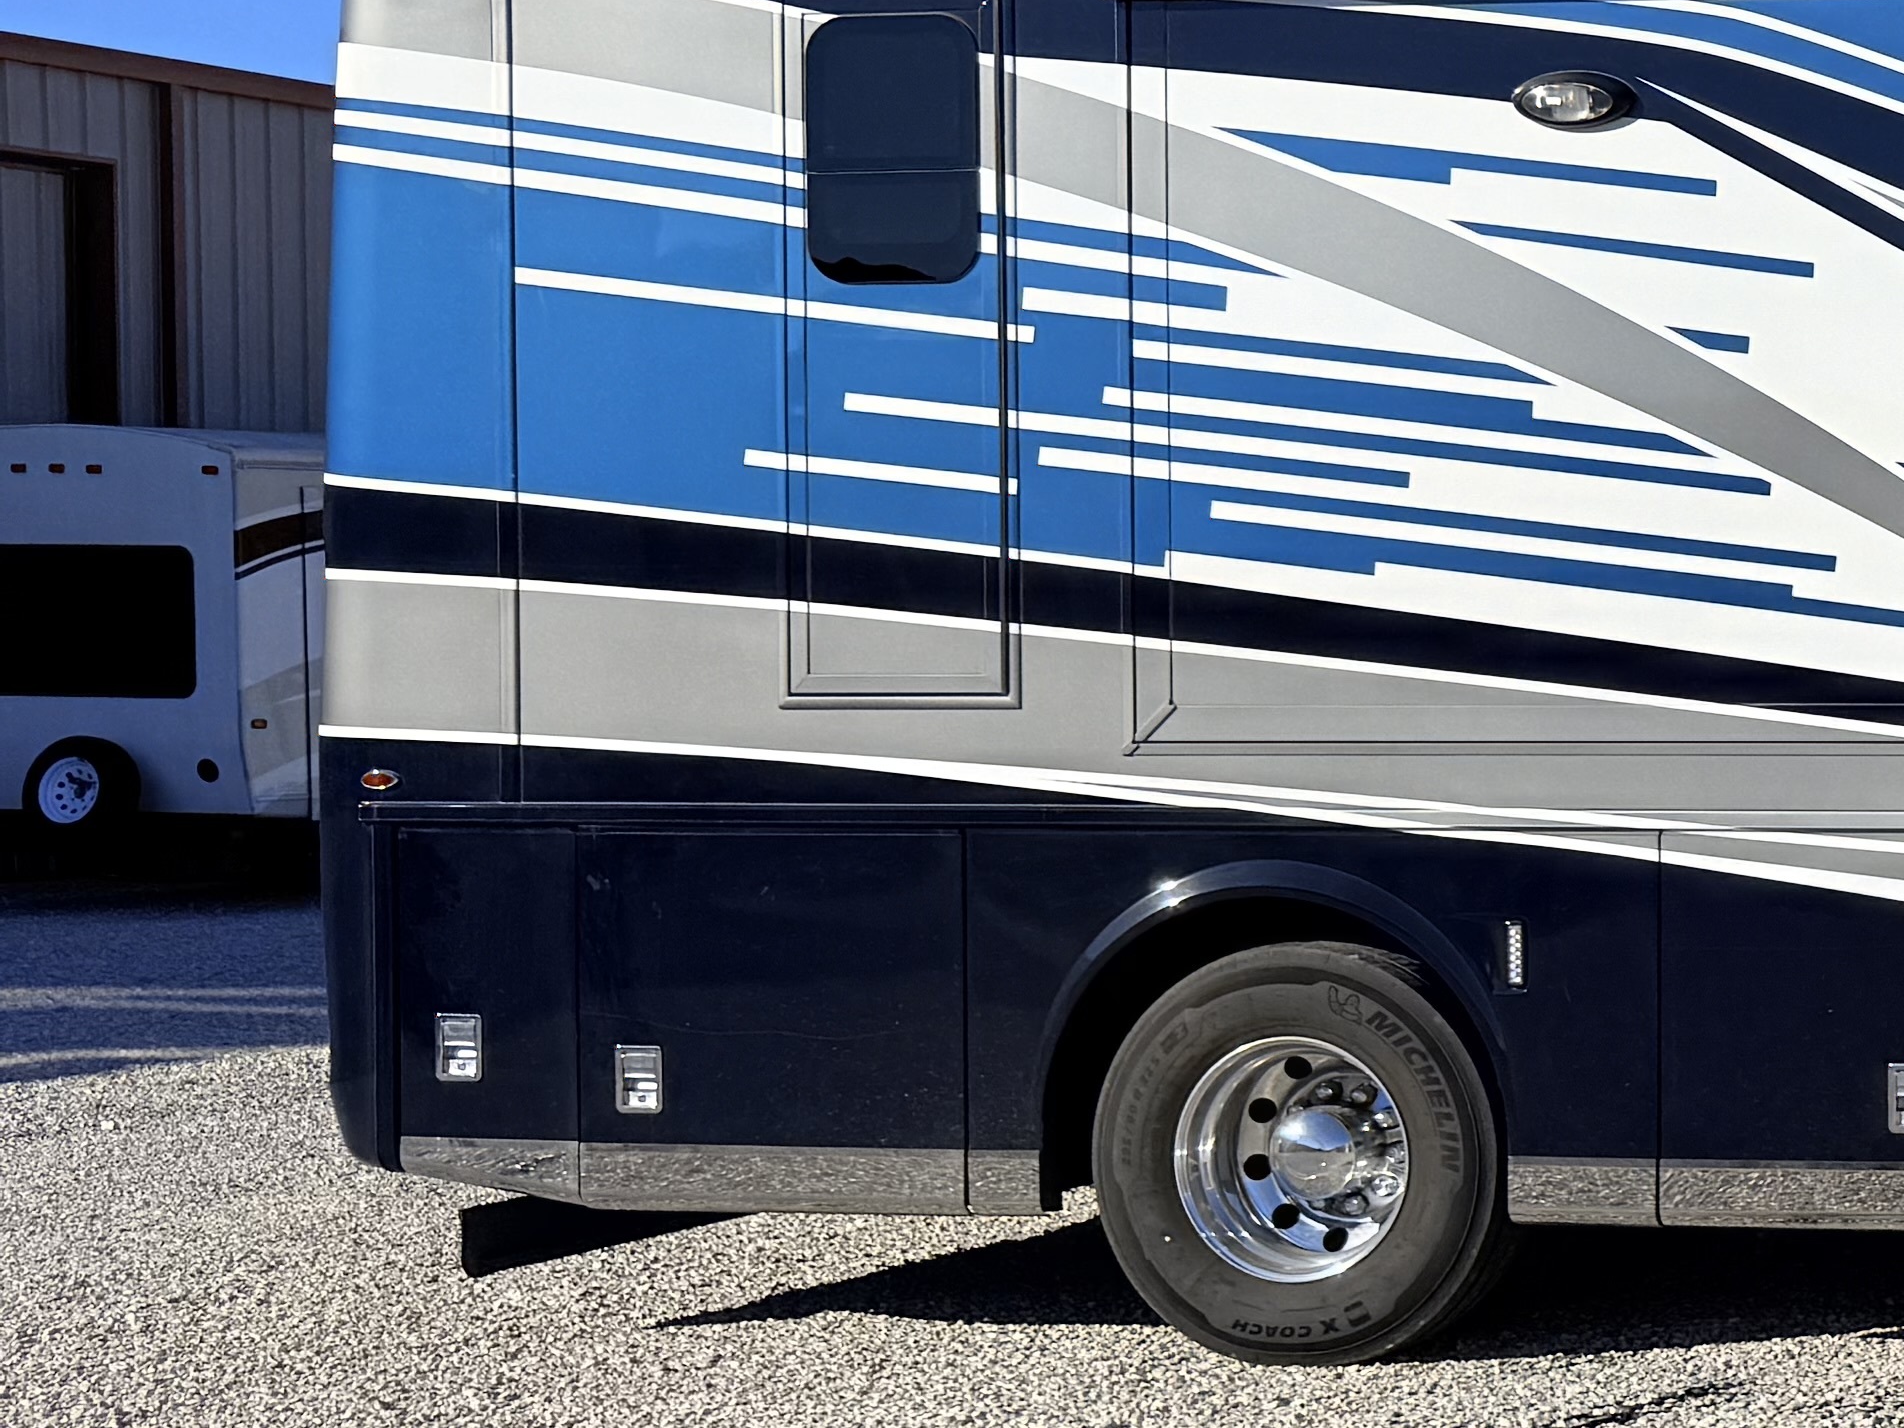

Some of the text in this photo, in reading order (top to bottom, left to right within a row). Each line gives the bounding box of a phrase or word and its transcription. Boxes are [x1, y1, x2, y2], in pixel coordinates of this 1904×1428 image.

[1365, 1010, 1460, 1173] MICHELIN
[1231, 1317, 1340, 1338] X COACH
